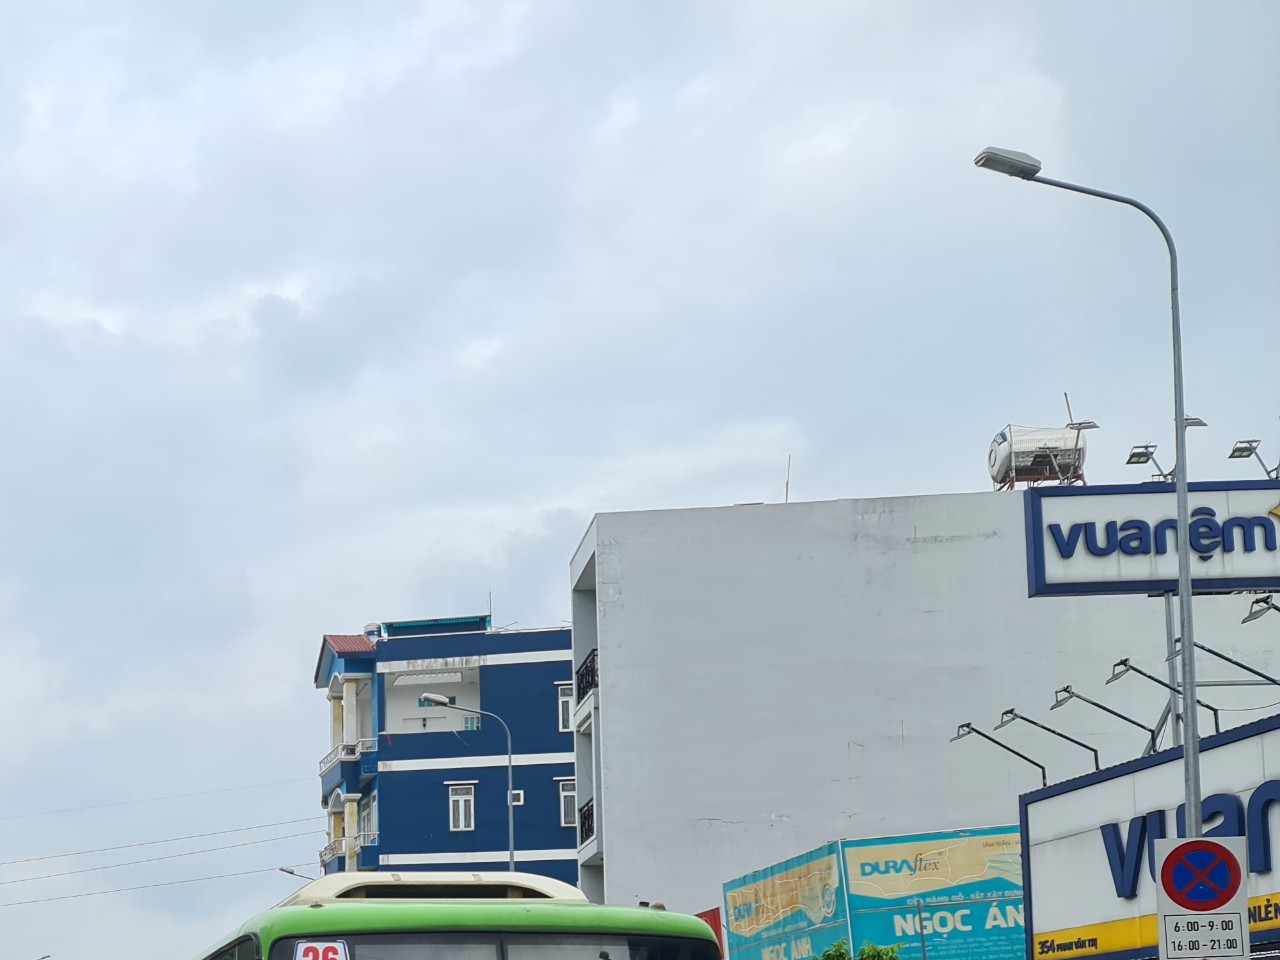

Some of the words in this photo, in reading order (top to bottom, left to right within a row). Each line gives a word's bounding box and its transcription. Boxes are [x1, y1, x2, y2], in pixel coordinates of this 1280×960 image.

[892, 909, 973, 938] NGỌC
[985, 902, 1025, 930] ÁN
[1038, 938, 1055, 955] 354
